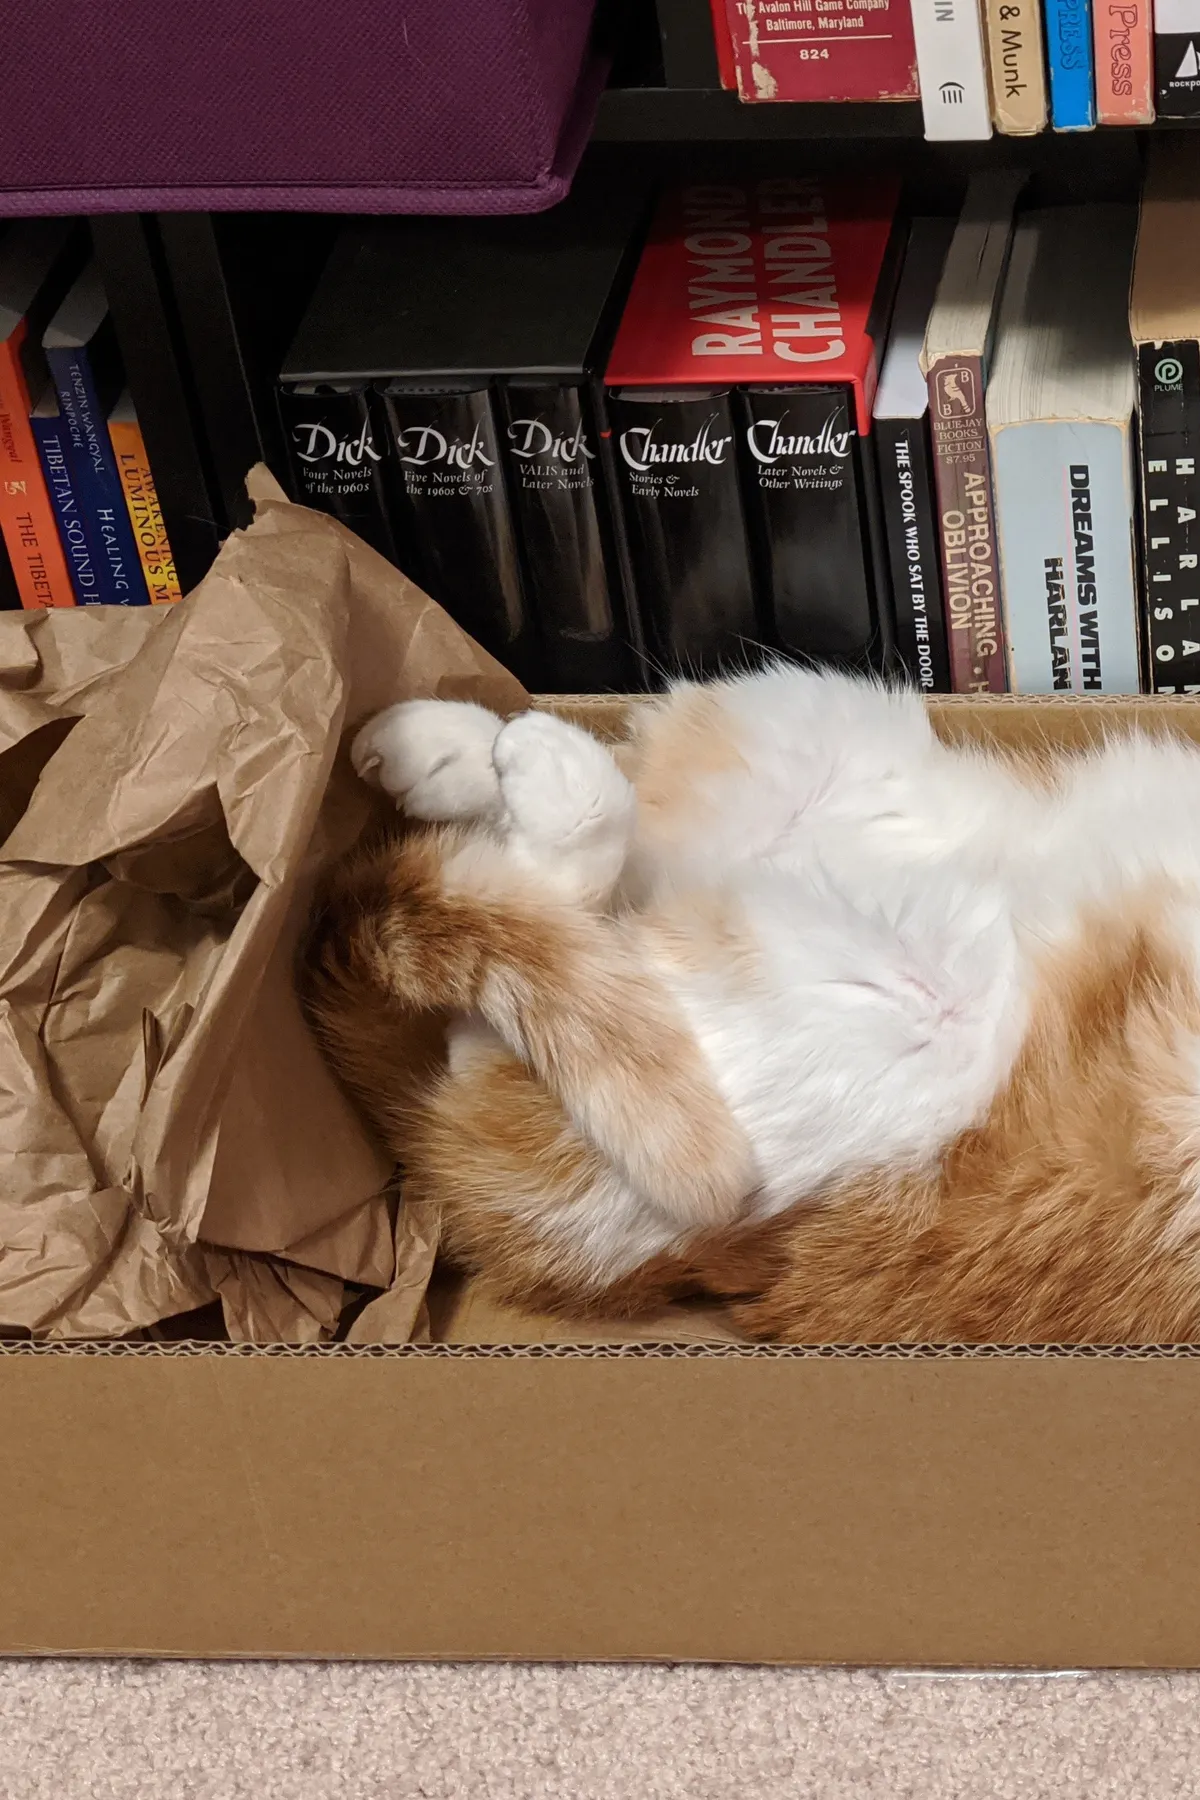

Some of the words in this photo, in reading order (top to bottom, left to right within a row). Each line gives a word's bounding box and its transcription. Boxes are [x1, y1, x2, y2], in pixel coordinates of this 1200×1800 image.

[759, 1, 791, 13] Avalon
[793, 0, 812, 12] Hill
[814, 0, 844, 11] Game
[846, 0, 890, 11] Company
[999, 5, 1020, 21] &
[766, 18, 815, 31] Baltimore,
[817, 15, 864, 30] Maryland
[1058, 0, 1084, 70] PRESS
[800, 49, 829, 60] 824
[1001, 29, 1027, 98] Munk
[1108, 4, 1138, 96] Press
[682, 184, 763, 356] RAYMOND
[1154, 384, 1184, 392] PLUME
[60, 391, 83, 448] RINPOCHE
[69, 364, 88, 408] TENZIN
[81, 412, 105, 473] WANGYAL
[747, 405, 856, 464] Chandler
[933, 418, 983, 430] BLUEJAY
[939, 428, 978, 440] BOOKS
[292, 406, 382, 466] Dick
[397, 411, 495, 469] Dick
[507, 414, 596, 463] Dick
[620, 412, 732, 471] Chandler
[937, 441, 982, 453] FICTION
[895, 439, 908, 468] THE
[946, 454, 976, 464] $7.95
[303, 467, 328, 480] Four
[333, 466, 372, 481] Novels
[404, 470, 428, 484] Five
[433, 471, 471, 484] Novels
[474, 469, 488, 484] of
[519, 464, 558, 476] VALIS
[560, 464, 585, 476] and
[522, 478, 553, 490] Later
[558, 476, 595, 490] Novels
[629, 471, 663, 485] Stories
[665, 474, 680, 485] &
[757, 465, 787, 477] Later
[791, 465, 826, 477] Novels
[829, 464, 843, 475] &
[759, 477, 790, 489] Other
[793, 478, 843, 491] Writings
[305, 482, 315, 494] of
[317, 483, 334, 494] the
[338, 482, 370, 494] 1960s
[406, 484, 423, 496] the
[427, 485, 455, 497] 1960s
[458, 485, 473, 496] &
[476, 484, 493, 495] 70s
[632, 485, 660, 499] Early
[664, 486, 699, 498] Novels
[898, 471, 917, 523] SPOOK
[43, 435, 77, 513] TIBETAN
[64, 520, 95, 587] SOUND
[120, 454, 163, 575] LUMINOUS
[16, 511, 38, 548] THE
[904, 526, 920, 561] WHO
[1069, 465, 1098, 606] DREAMS
[97, 508, 129, 590] HEALING
[963, 471, 998, 657] APPROACHING
[908, 565, 924, 591] SAT
[941, 510, 973, 630] OBLIVION
[911, 593, 926, 613] BY
[914, 616, 929, 642] THE
[1044, 557, 1072, 691] HARLAN
[1079, 610, 1102, 690] WITH
[917, 645, 934, 689] DOOR
